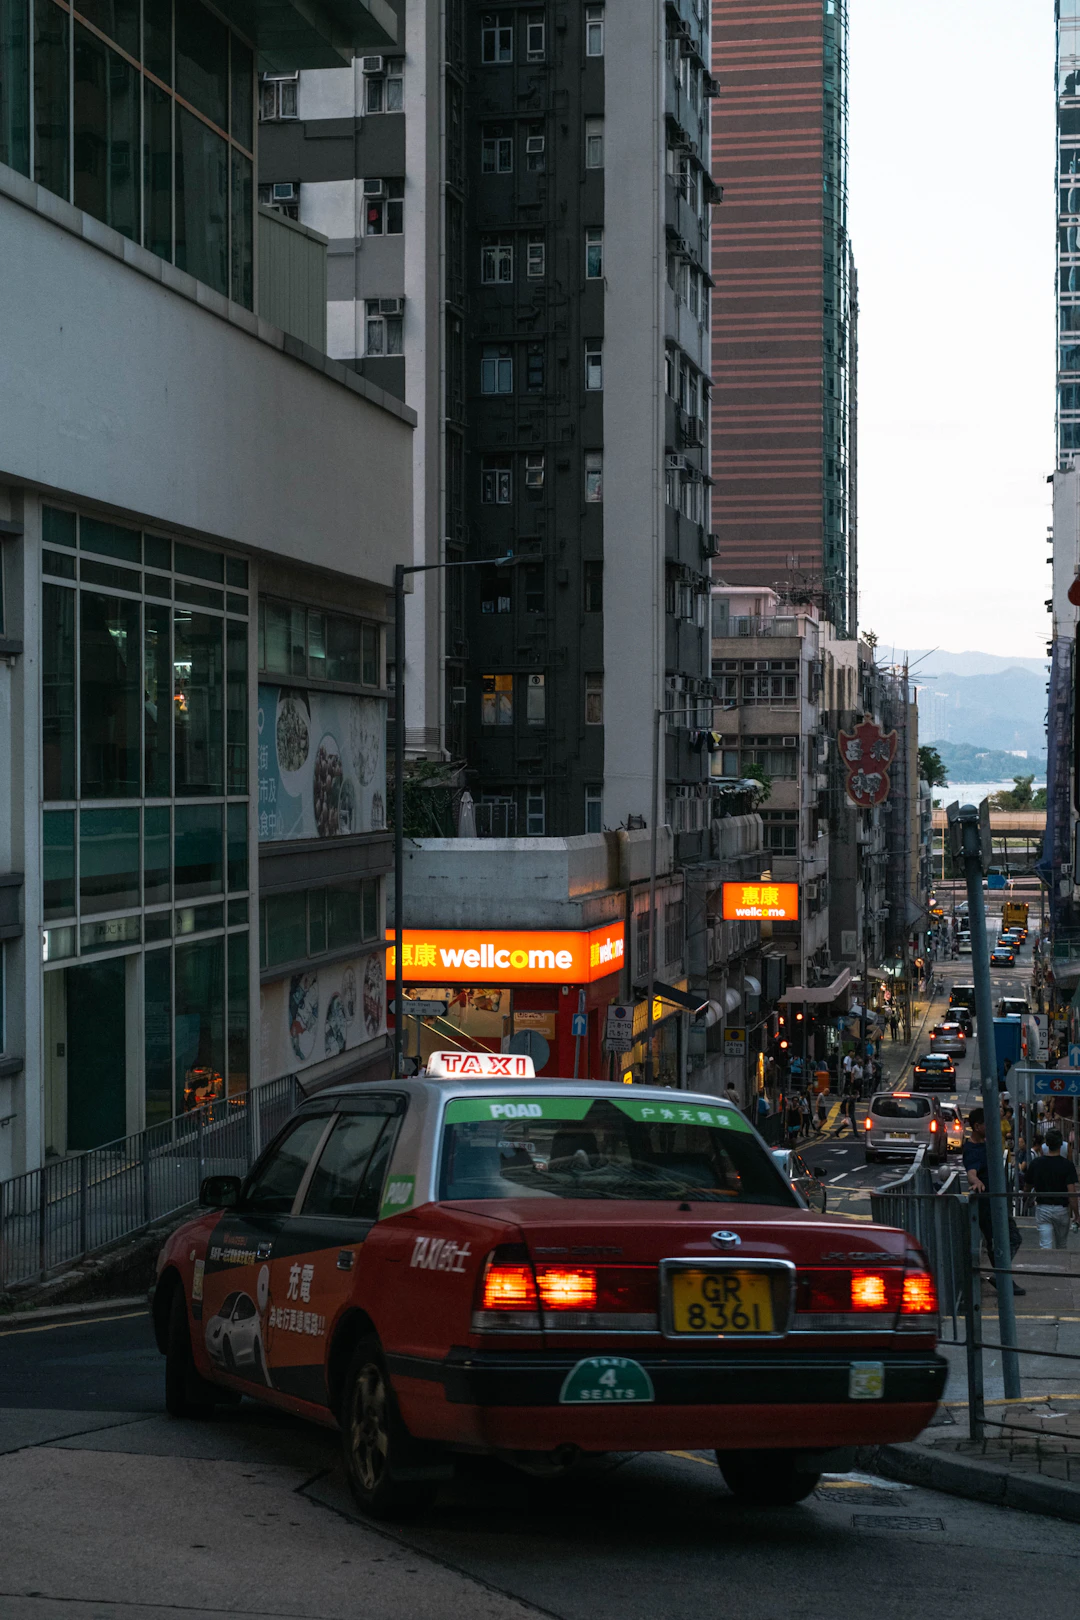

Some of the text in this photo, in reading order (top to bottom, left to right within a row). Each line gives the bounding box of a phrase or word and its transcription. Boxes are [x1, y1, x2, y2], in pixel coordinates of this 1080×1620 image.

[741, 886, 780, 905] 惠康
[735, 906, 786, 917] wellcome
[439, 944, 573, 969] wellcome
[600, 938, 624, 965] wellcome
[441, 1053, 526, 1077] TAXI
[490, 1103, 543, 1118] POAD
[286, 1262, 315, 1304] 充電
[702, 1275, 741, 1303] GR
[688, 1303, 760, 1330] 8361
[599, 1368, 617, 1388] 4
[580, 1389, 635, 1400] SEATS
